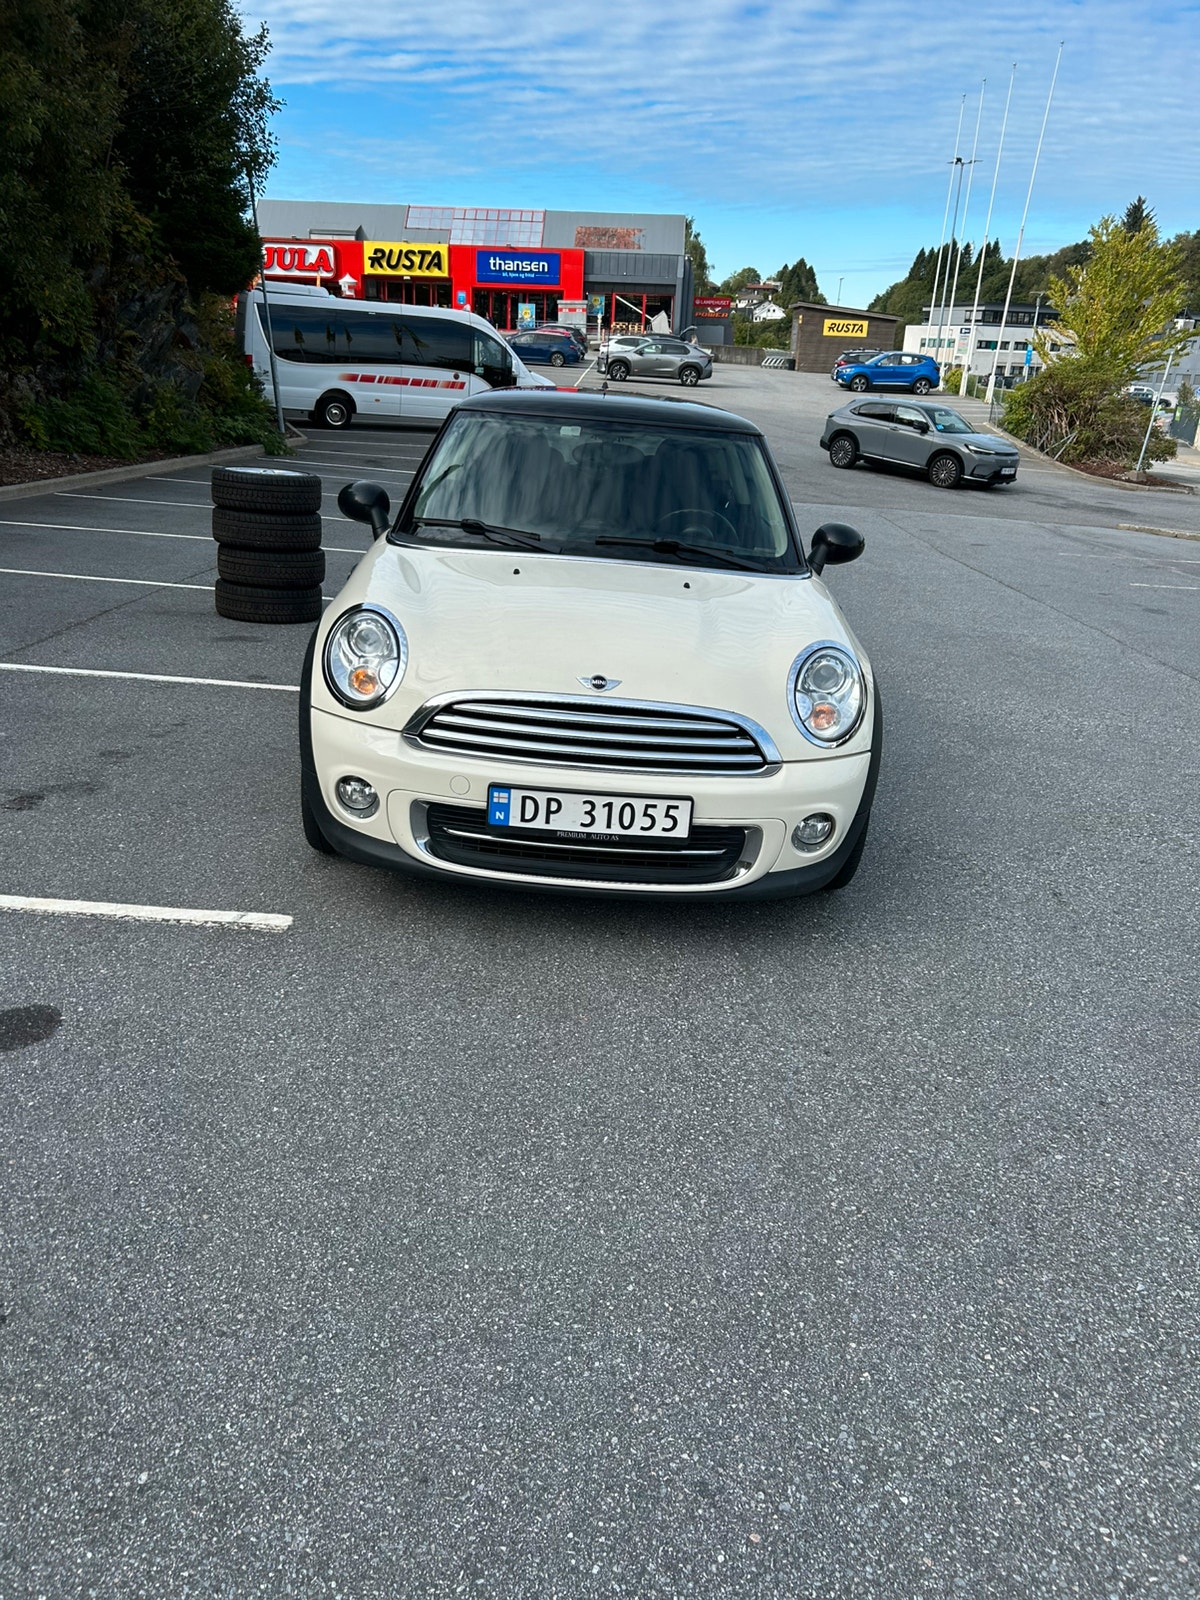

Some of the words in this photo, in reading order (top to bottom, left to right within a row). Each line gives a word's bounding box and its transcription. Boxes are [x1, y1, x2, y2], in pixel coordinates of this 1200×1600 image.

[264, 246, 333, 272] JULA
[368, 248, 442, 271] RUSTA
[489, 256, 548, 272] thansen
[827, 322, 864, 333] RUSTA
[495, 811, 504, 820] N
[520, 795, 562, 825] DP
[580, 799, 680, 832] 31055
[556, 831, 587, 839] PREMIUM
